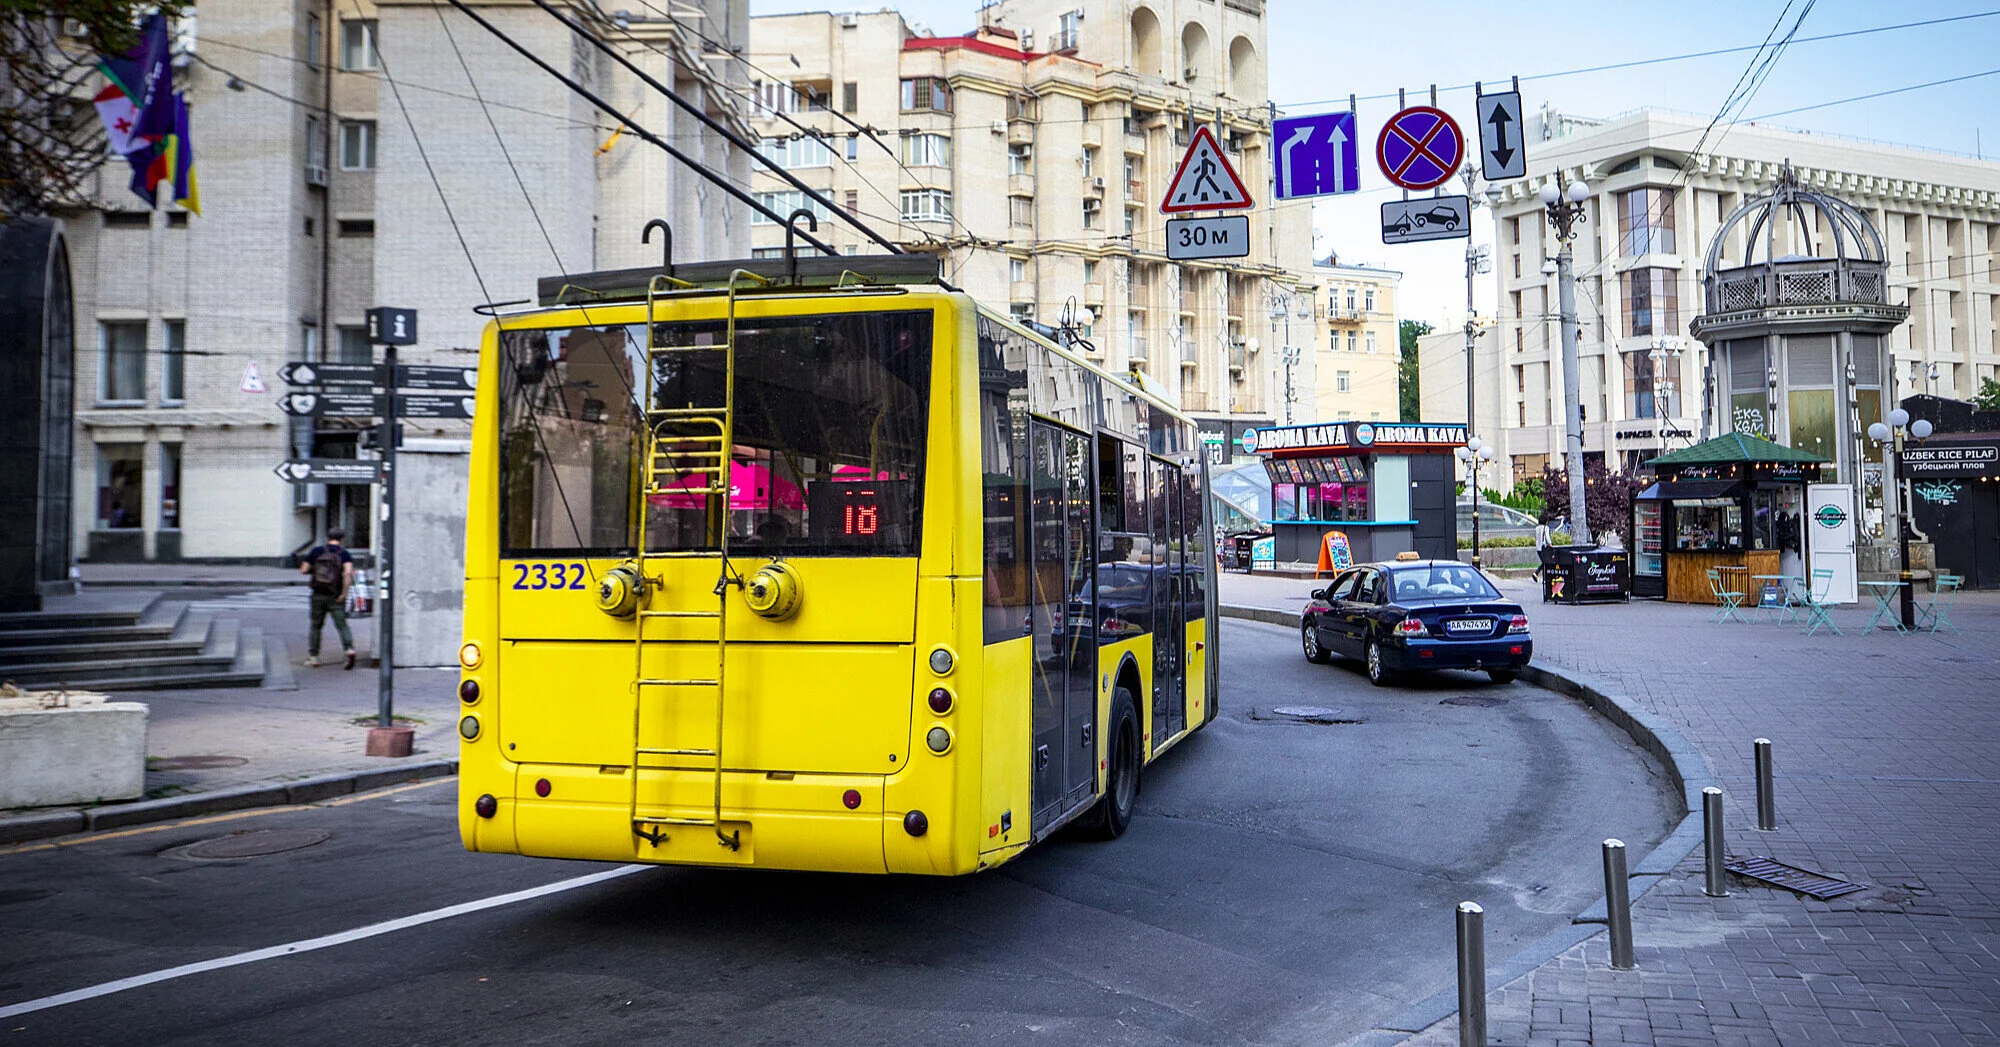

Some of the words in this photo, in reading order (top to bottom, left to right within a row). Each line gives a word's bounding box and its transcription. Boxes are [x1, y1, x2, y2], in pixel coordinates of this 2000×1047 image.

[1179, 226, 1207, 247] 30
[1258, 428, 1305, 449] AROMA
[1306, 425, 1347, 446] KAVA
[1374, 427, 1426, 442] AROMA
[1428, 428, 1466, 443] KAVA
[1902, 451, 1935, 460] UZBEK
[1938, 450, 1962, 459] RICE
[1965, 449, 1995, 459] PILAF
[1912, 462, 1960, 471] узбецький
[846, 491, 877, 535] 18
[512, 563, 586, 591] 2332
